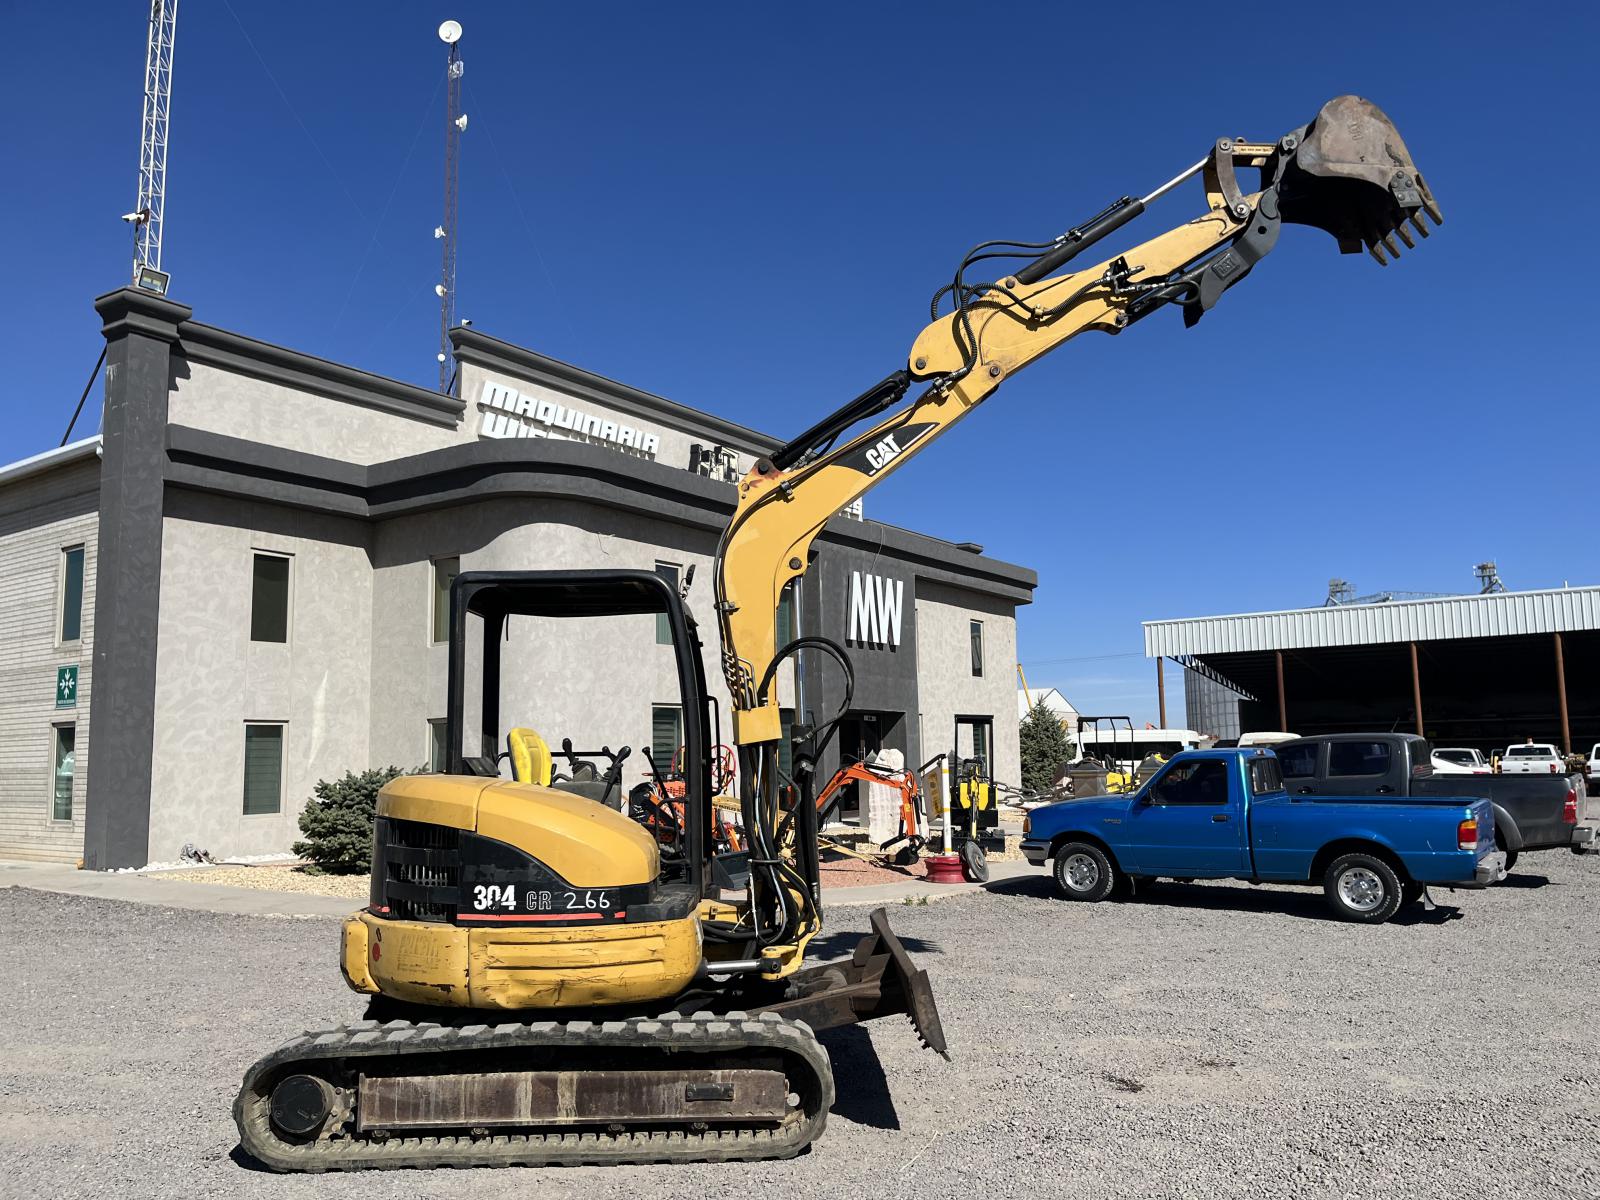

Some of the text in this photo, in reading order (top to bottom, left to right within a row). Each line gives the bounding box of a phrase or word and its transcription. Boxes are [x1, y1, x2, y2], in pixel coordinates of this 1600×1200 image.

[480, 380, 660, 454] MAQUINARIA
[865, 432, 902, 470] CAT
[850, 571, 904, 646] MW
[474, 885, 552, 911] 304 CR
[563, 890, 611, 909] 266
